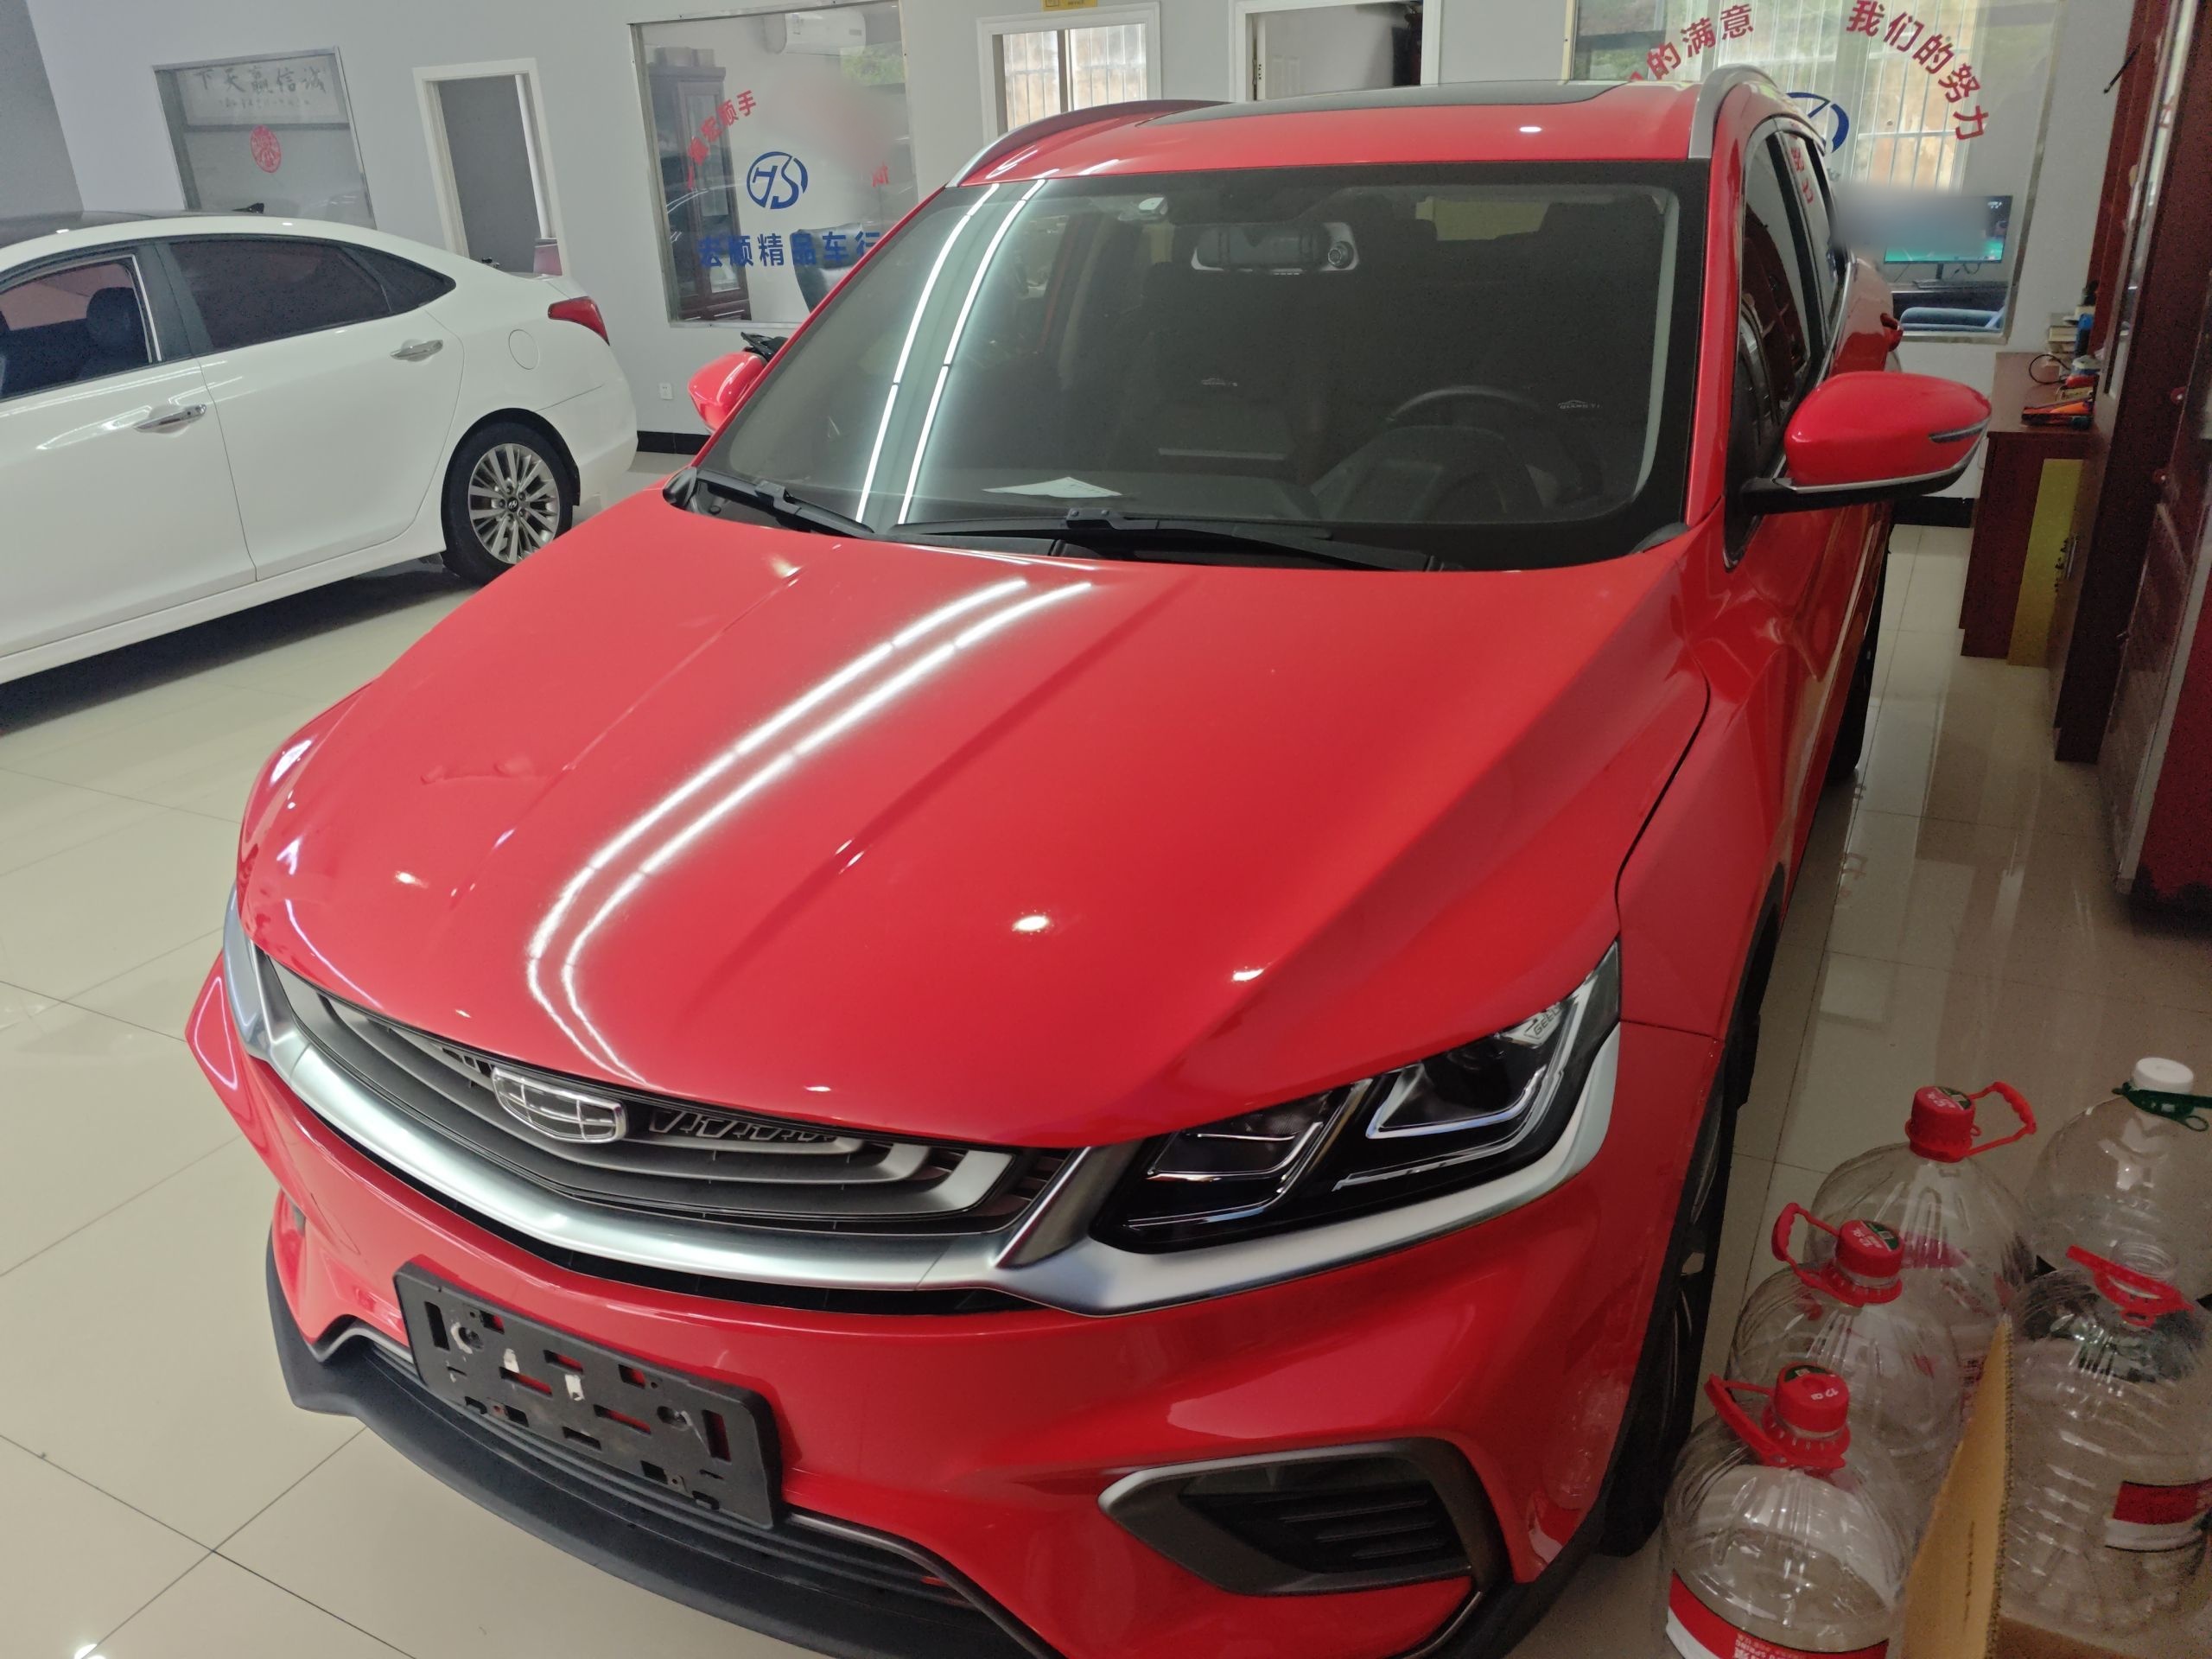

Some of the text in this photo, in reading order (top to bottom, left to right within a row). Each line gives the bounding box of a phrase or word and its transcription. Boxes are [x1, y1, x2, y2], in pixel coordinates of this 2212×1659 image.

[1630, 3, 1755, 81] 的满意
[1846, 0, 1989, 140] 我们的努力
[696, 231, 880, 268] 宏顺精品车行
[1533, 1003, 1562, 1036] GEEL
